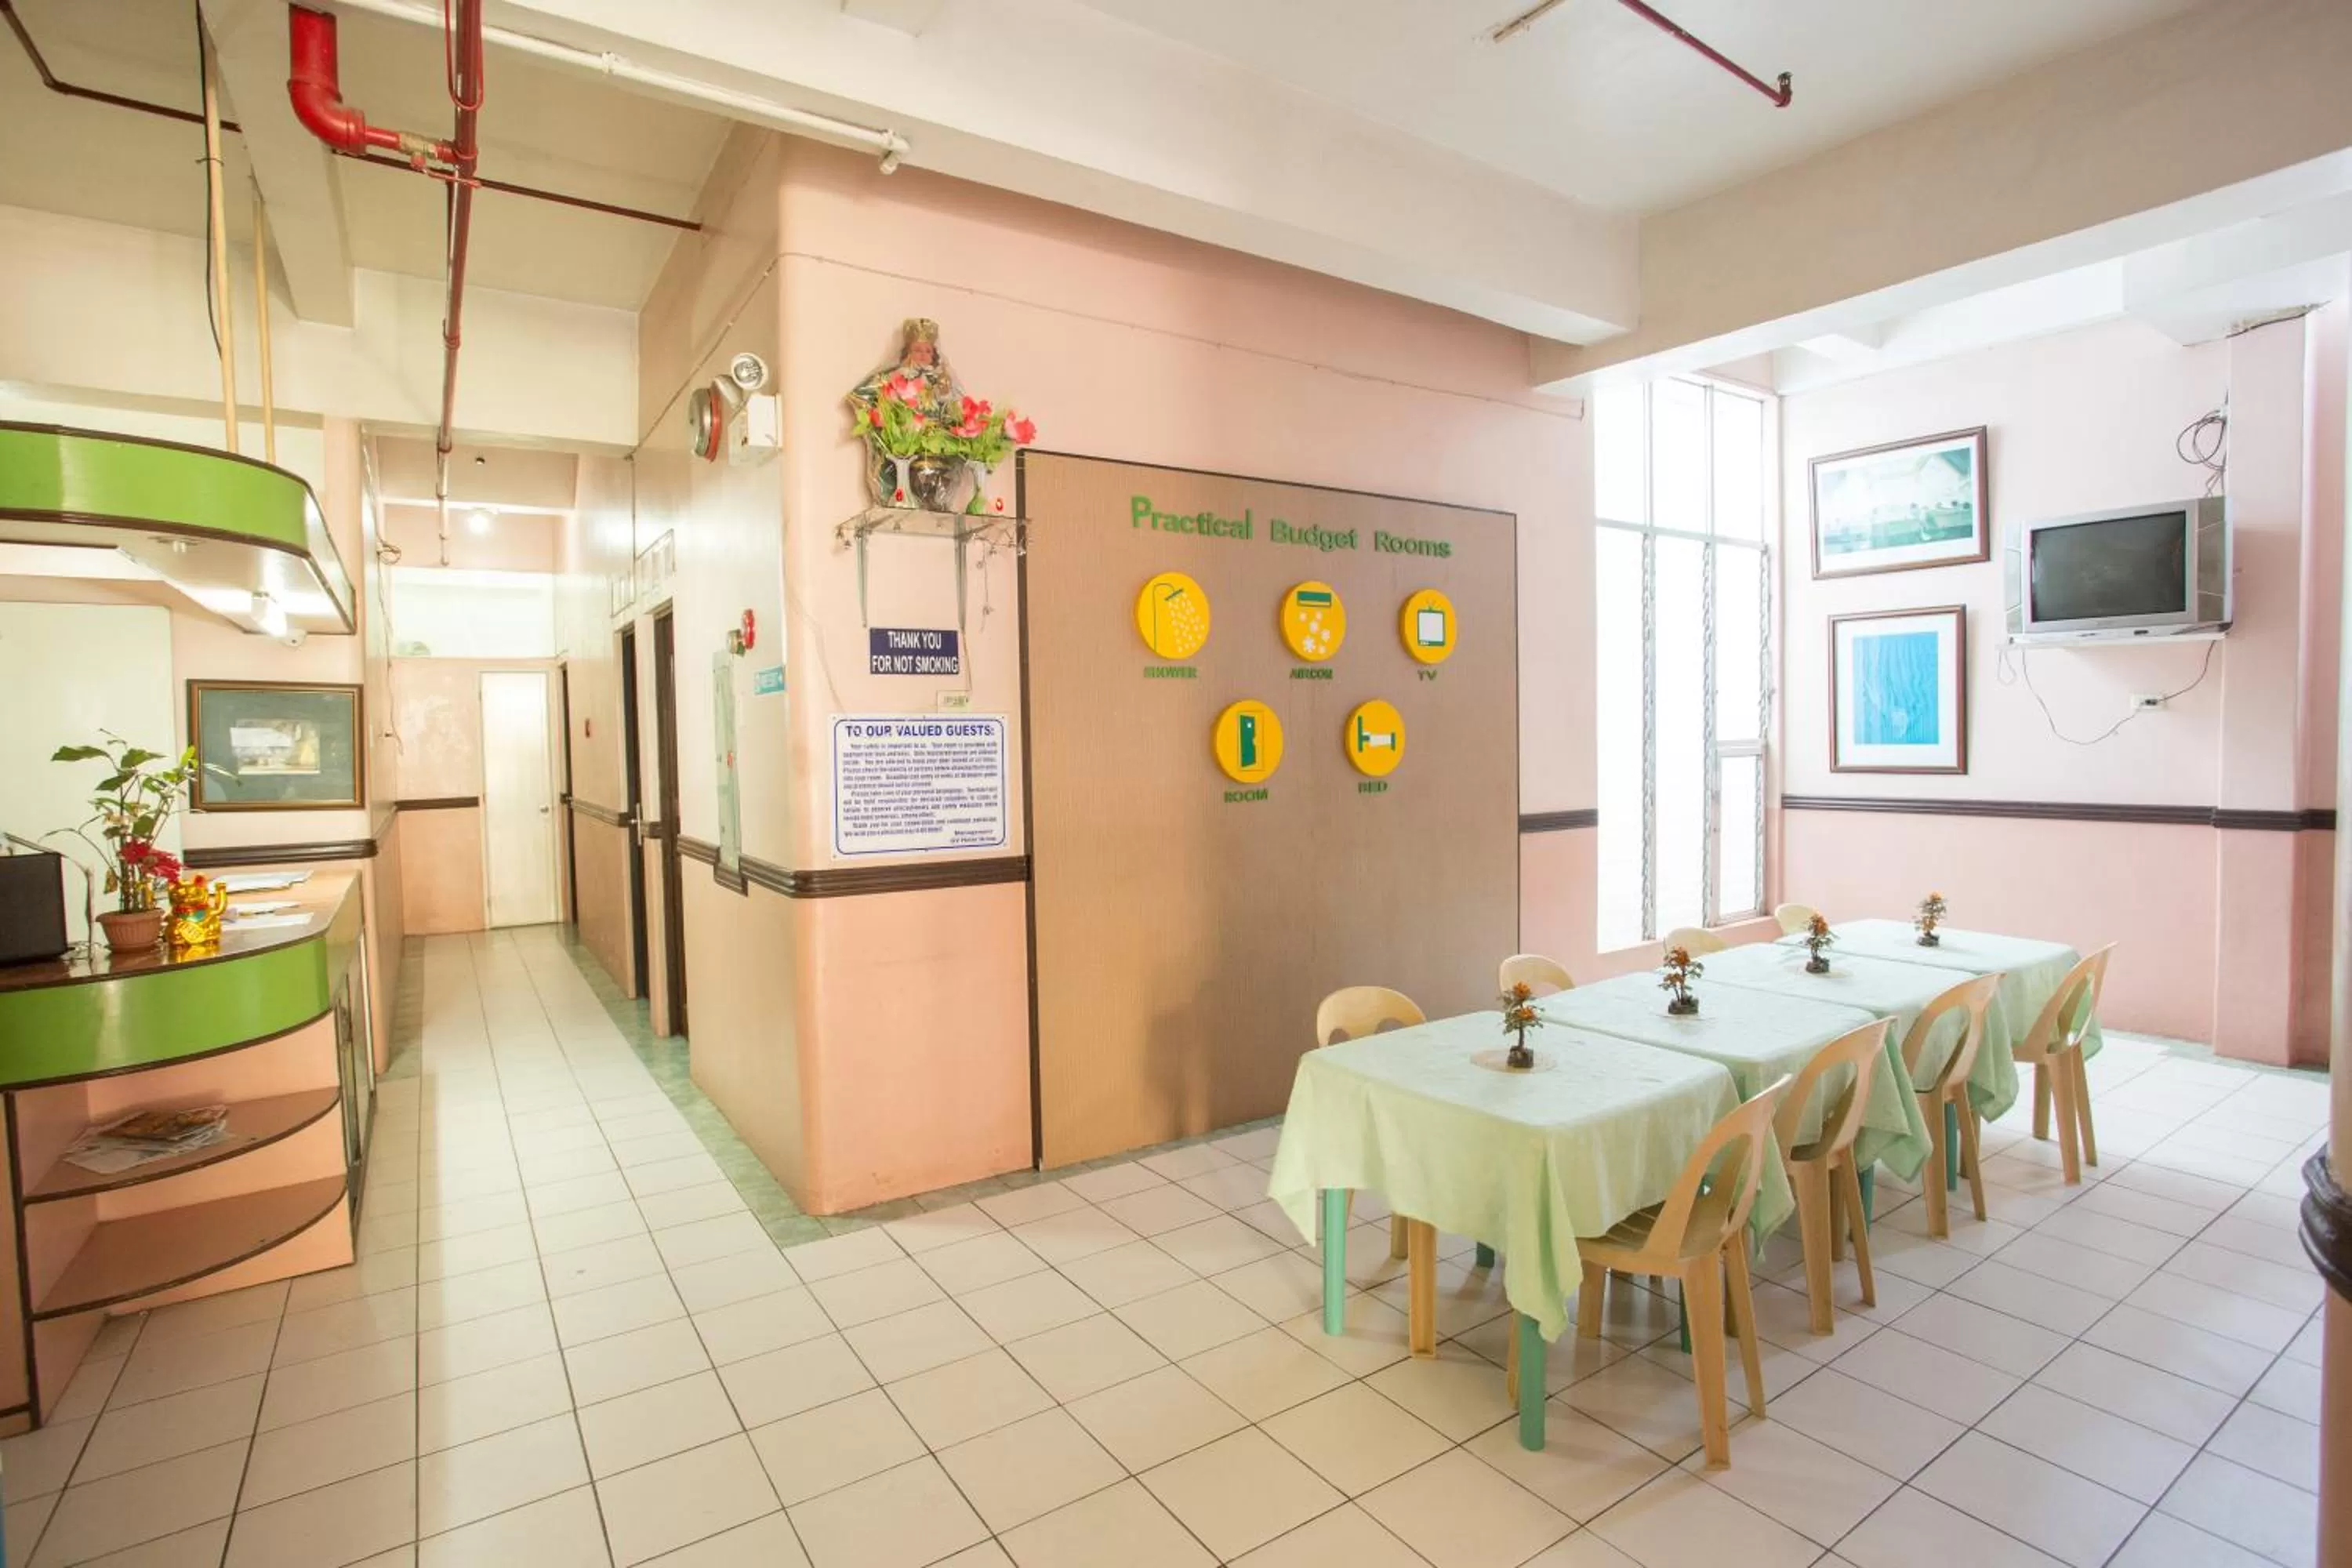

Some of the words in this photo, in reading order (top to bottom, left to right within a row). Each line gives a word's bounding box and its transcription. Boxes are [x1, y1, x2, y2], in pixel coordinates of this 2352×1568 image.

[1131, 495, 1253, 540] Practical
[1270, 519, 1358, 552] Budget
[1374, 529, 1452, 558] Rooms
[887, 630, 920, 648] THANK
[922, 632, 942, 649] YOU
[872, 655, 892, 672] FOR
[893, 655, 913, 672] NOT
[915, 655, 958, 673] SMOKING
[1144, 666, 1198, 678] SHOWER
[1289, 667, 1334, 680] AIRCON
[1417, 670, 1438, 681] TV
[845, 725, 862, 736] TO
[866, 725, 892, 736] OUR
[896, 724, 942, 736] VALUED
[946, 724, 995, 736] GUESTS:
[1357, 781, 1388, 793] BED
[1225, 788, 1269, 803] ROOM
